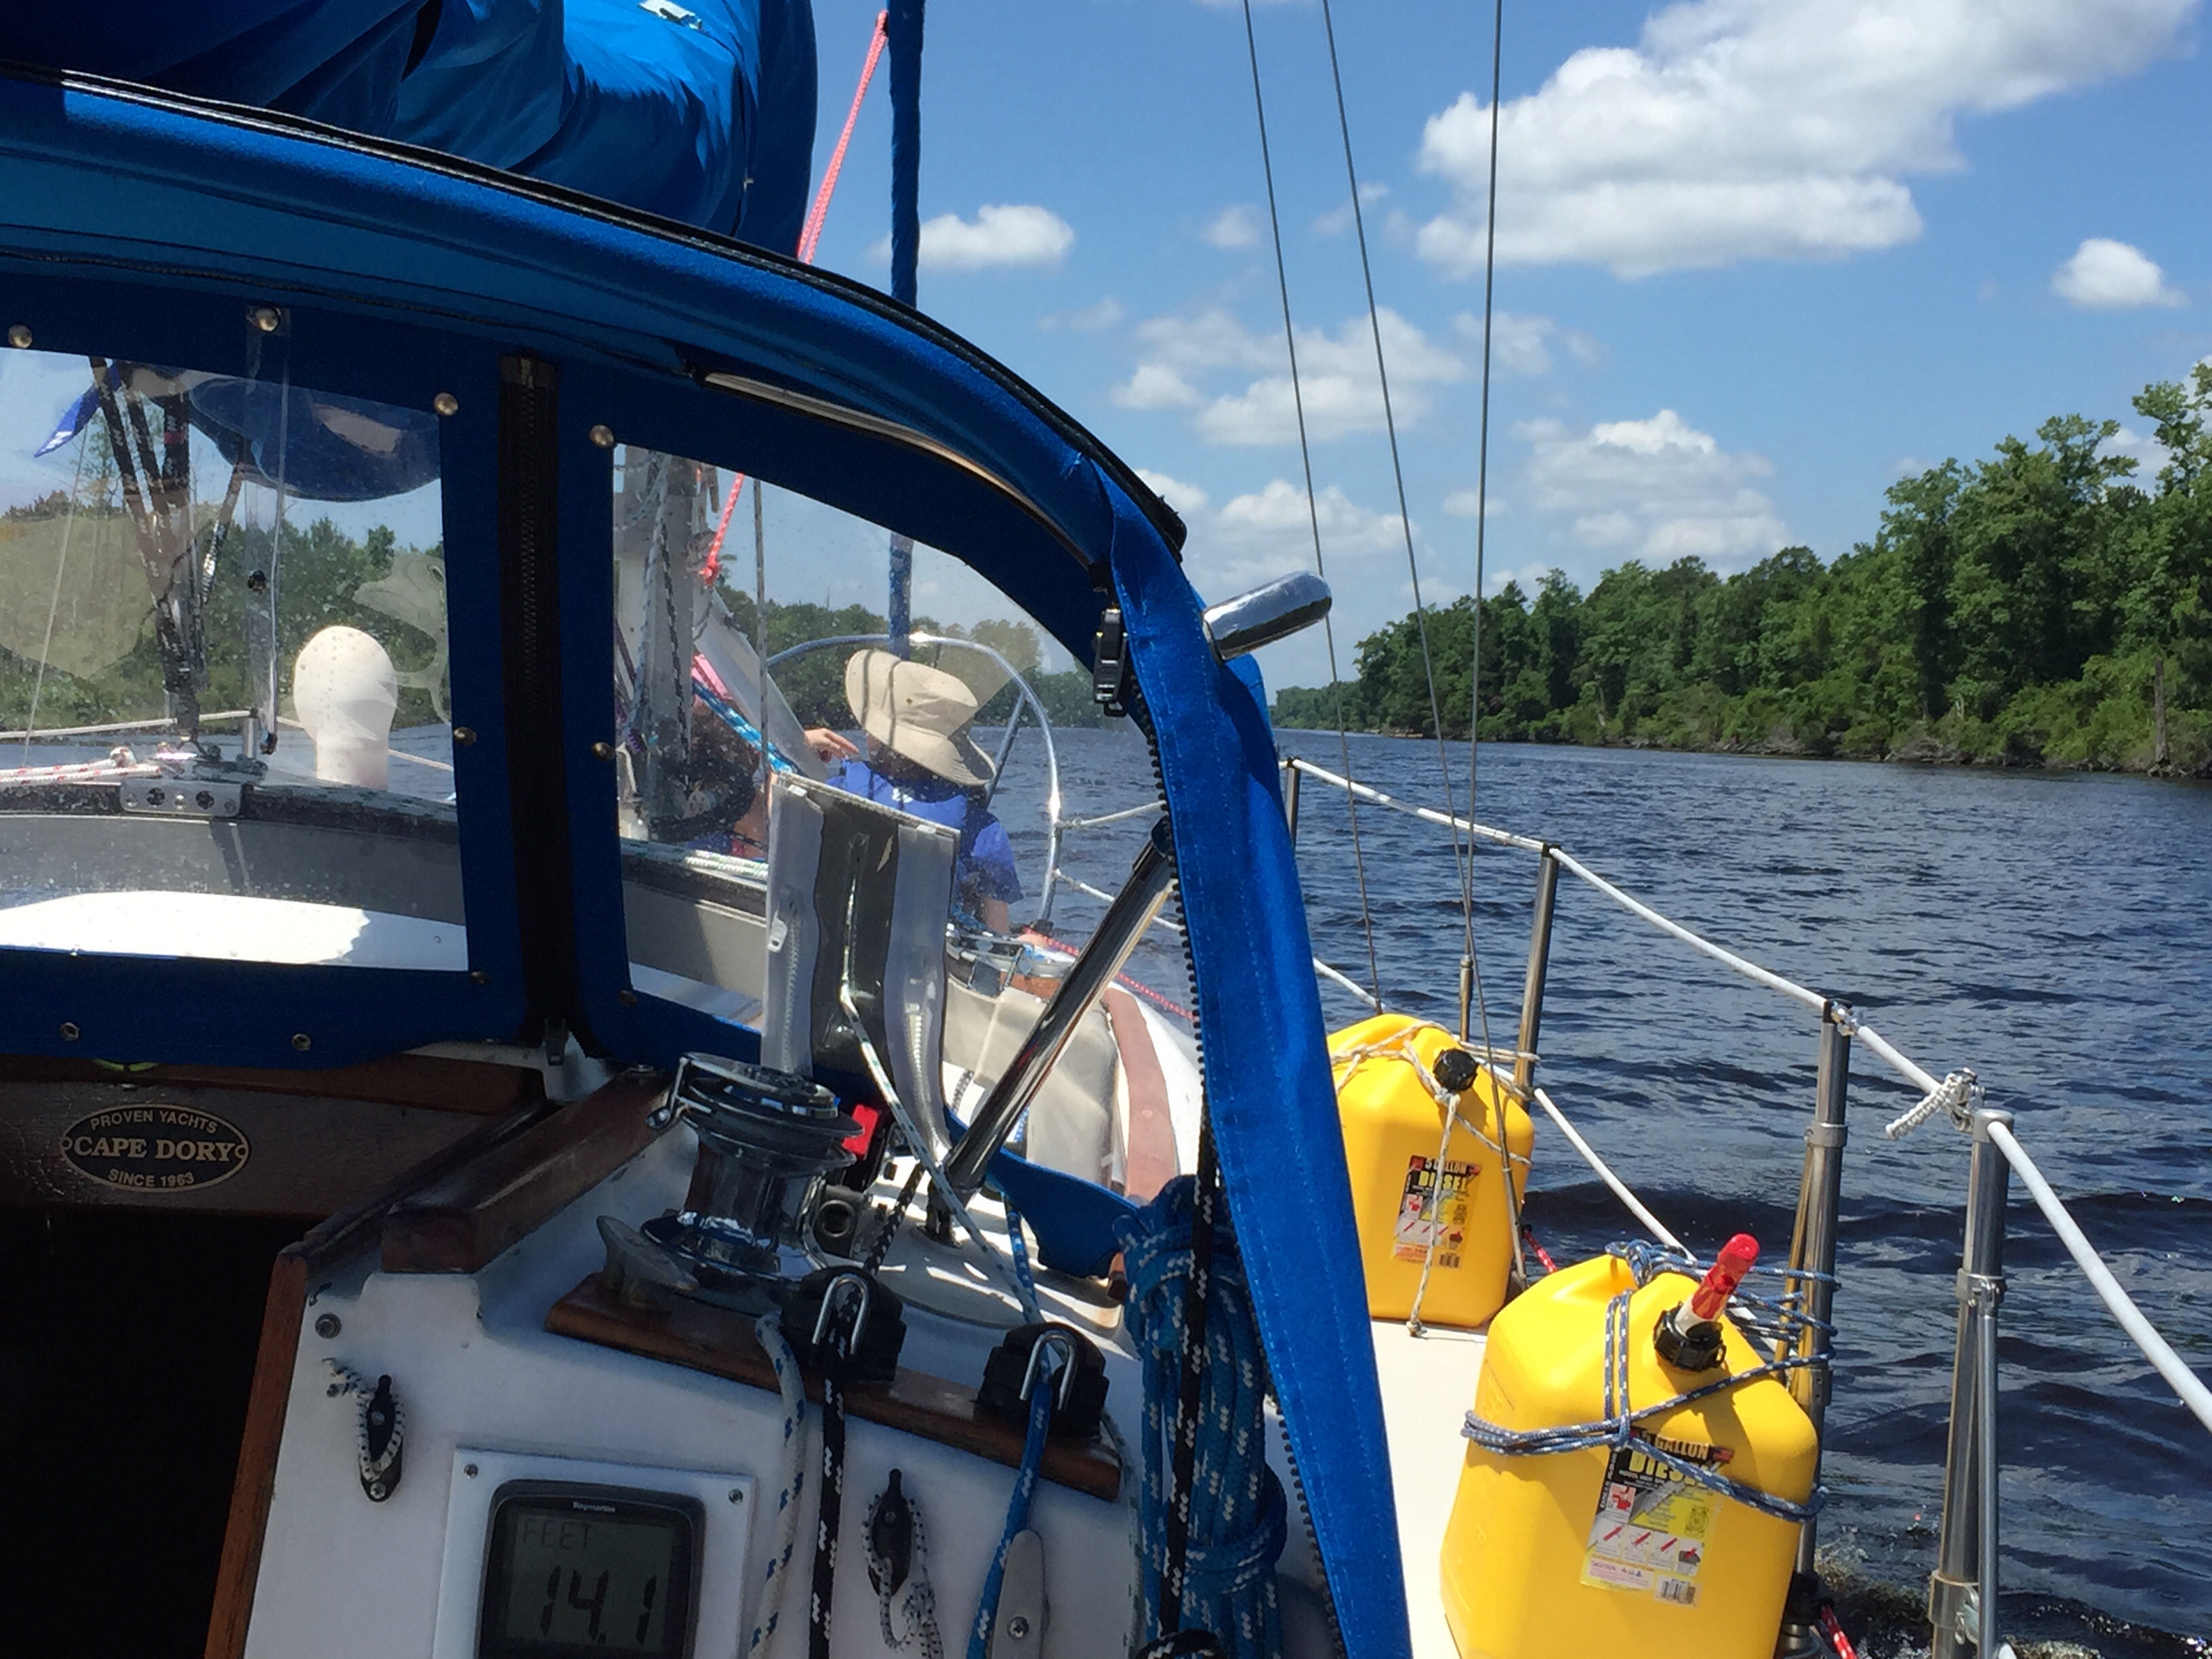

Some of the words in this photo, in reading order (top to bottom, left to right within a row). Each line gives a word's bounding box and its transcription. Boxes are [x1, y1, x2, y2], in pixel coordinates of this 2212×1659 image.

[89, 1110, 154, 1130] PROVEN
[159, 1111, 218, 1134] YACHTS
[74, 1136, 148, 1158] CAPE
[155, 1140, 236, 1162] DORY
[108, 1168, 155, 1187] SINCE
[160, 1172, 194, 1187] 1963
[1418, 1170, 1468, 1192] DISEL
[1655, 1435, 1710, 1460] GALLON
[523, 1518, 590, 1551] FEET
[540, 1565, 657, 1645] 14.1
